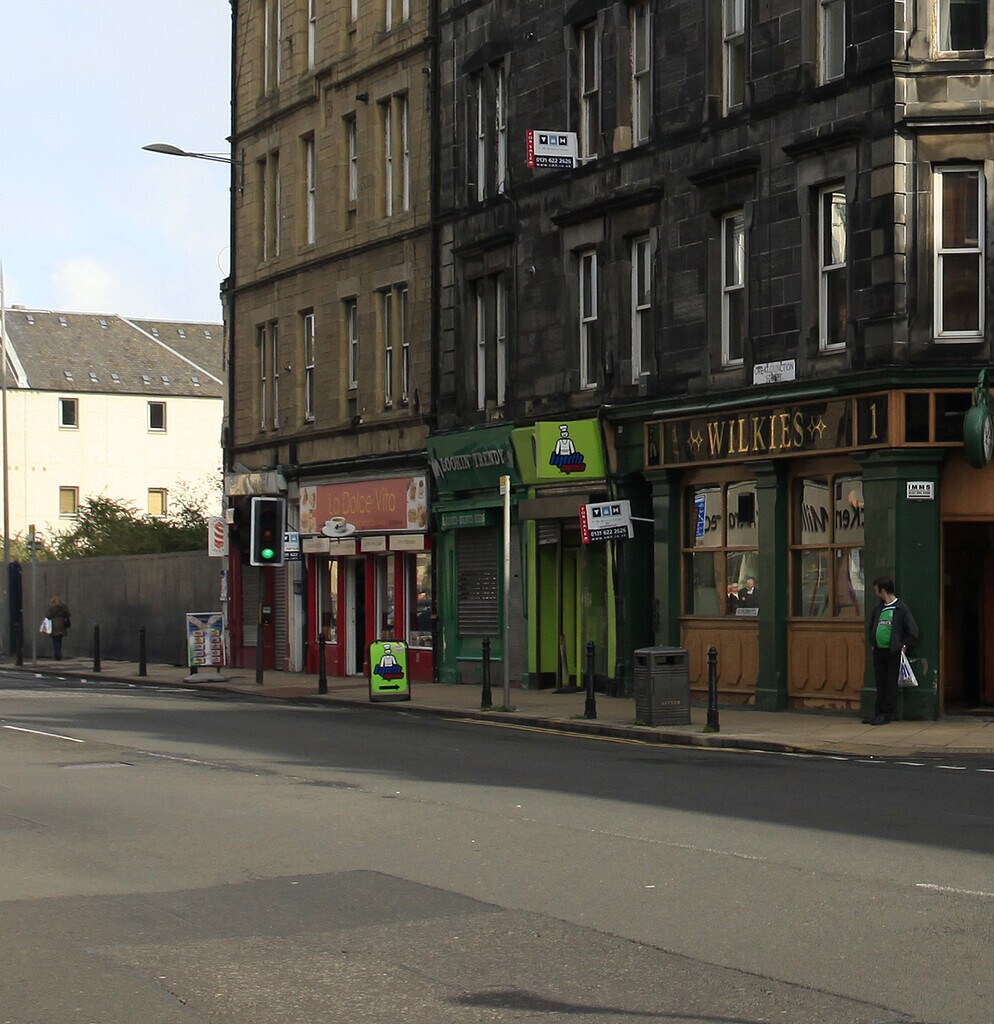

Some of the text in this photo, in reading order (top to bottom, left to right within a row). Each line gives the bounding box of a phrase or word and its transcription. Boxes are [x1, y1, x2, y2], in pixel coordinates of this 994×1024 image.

[706, 402, 878, 455] WILKIES 1
[472, 449, 505, 468] TRENDY
[343, 490, 372, 514] Dolce
[375, 487, 396, 512] Vita
